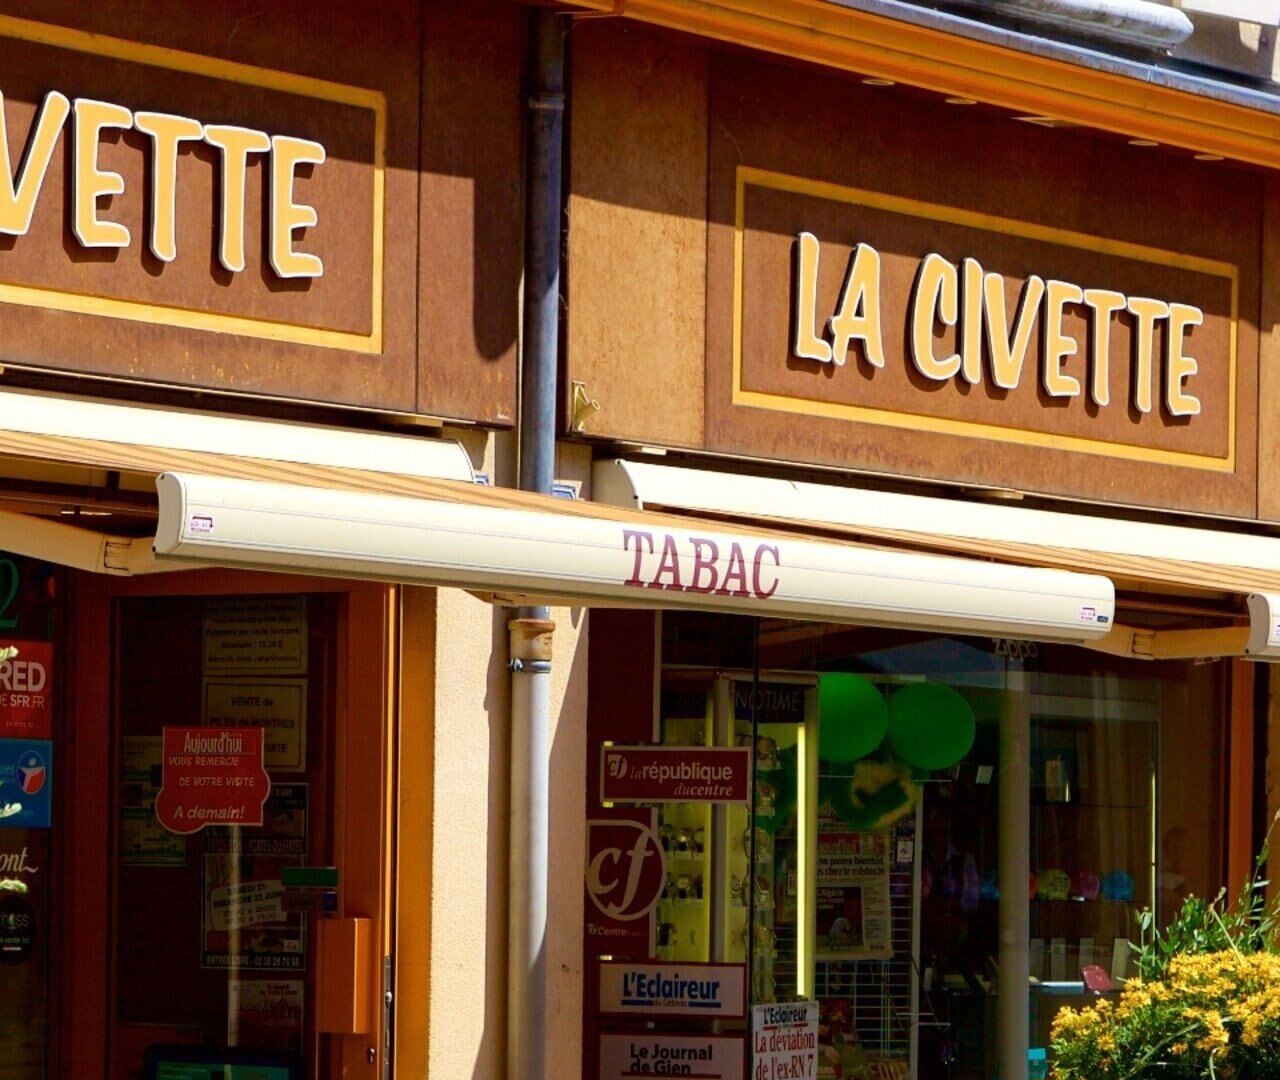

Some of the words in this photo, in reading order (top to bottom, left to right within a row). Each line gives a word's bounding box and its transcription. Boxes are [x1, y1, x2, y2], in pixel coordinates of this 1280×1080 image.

[796, 231, 885, 369] LA
[912, 253, 1203, 416] CIVETTE
[623, 529, 780, 600] TABAC
[183, 732, 243, 755] Aujourd'hui
[168, 756, 192, 767] VOUS
[195, 756, 240, 767] REMERCIE
[178, 776, 191, 787] DE
[193, 776, 223, 787] VOTRE
[226, 776, 256, 787] VISITE
[174, 806, 184, 819] A
[187, 805, 245, 820] demain!
[623, 972, 720, 999] L'Eclaireur
[630, 1043, 648, 1059] Le
[652, 1044, 713, 1061] Journal
[755, 1031, 766, 1053] La
[770, 1028, 815, 1052] déviation
[630, 1059, 650, 1074] de
[654, 1060, 691, 1075] Gien
[771, 1055, 805, 1080] l'ex-RN
[808, 1053, 814, 1078] 7
